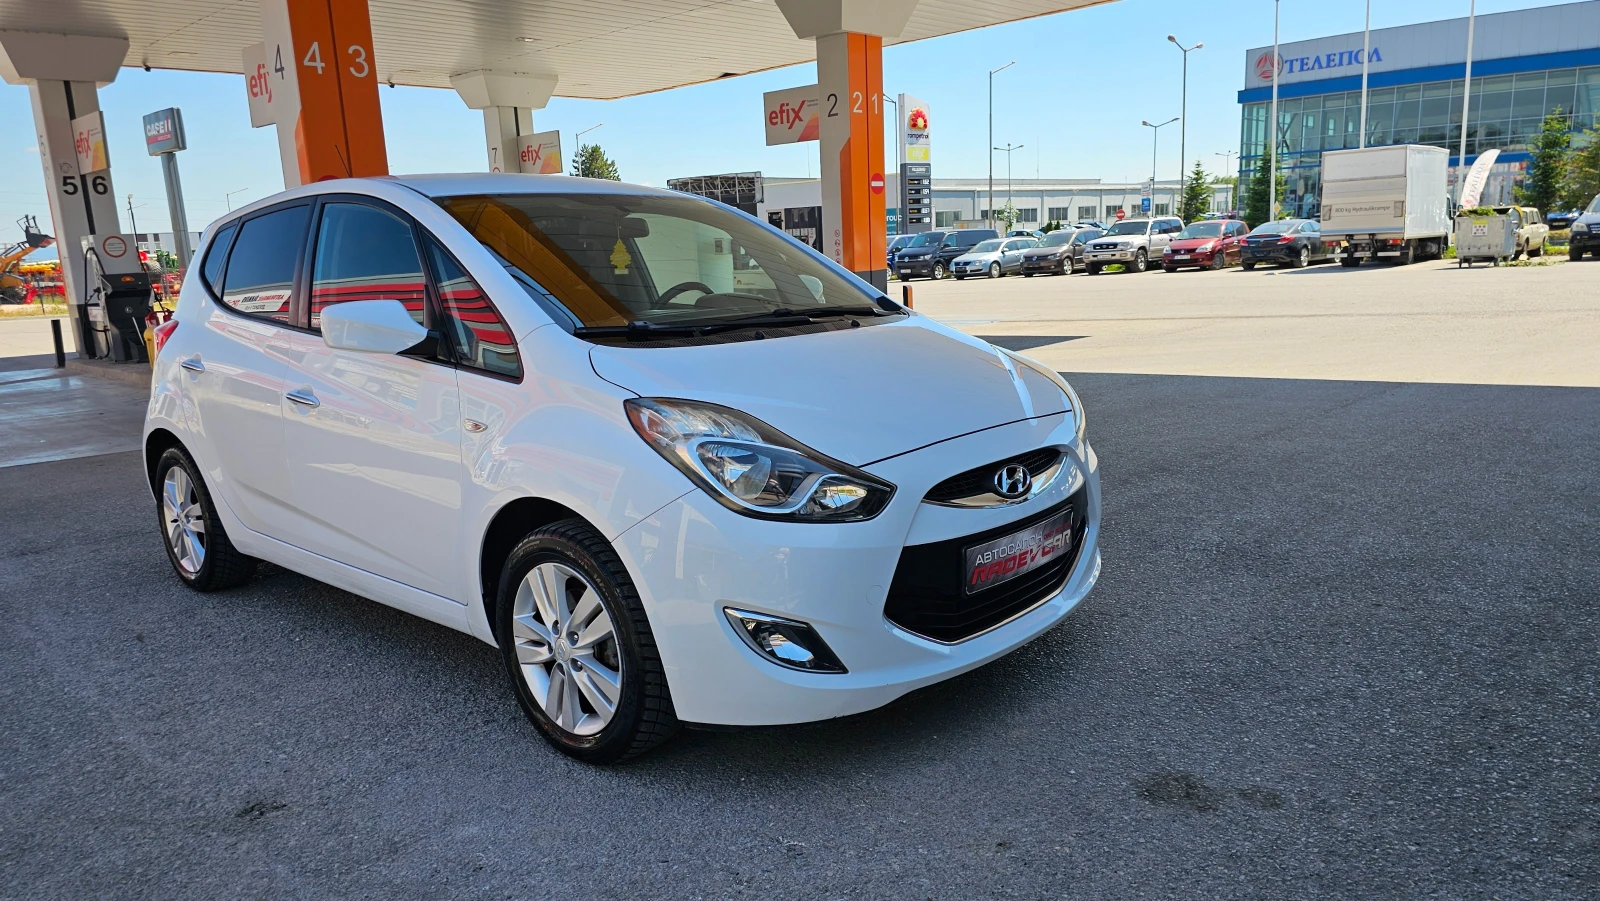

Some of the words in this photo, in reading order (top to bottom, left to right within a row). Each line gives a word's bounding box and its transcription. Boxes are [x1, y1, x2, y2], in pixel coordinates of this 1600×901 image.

[274, 44, 285, 80] 4
[303, 41, 326, 75] 4
[347, 45, 369, 78] 3
[249, 63, 273, 104] efi
[768, 99, 806, 130] efix
[827, 93, 839, 118] 2
[852, 91, 863, 114] 2
[871, 93, 878, 115] 1
[76, 130, 91, 158] efix
[491, 147, 498, 164] 7
[521, 143, 542, 165] efix
[62, 175, 79, 196] 5
[92, 175, 109, 196] 6
